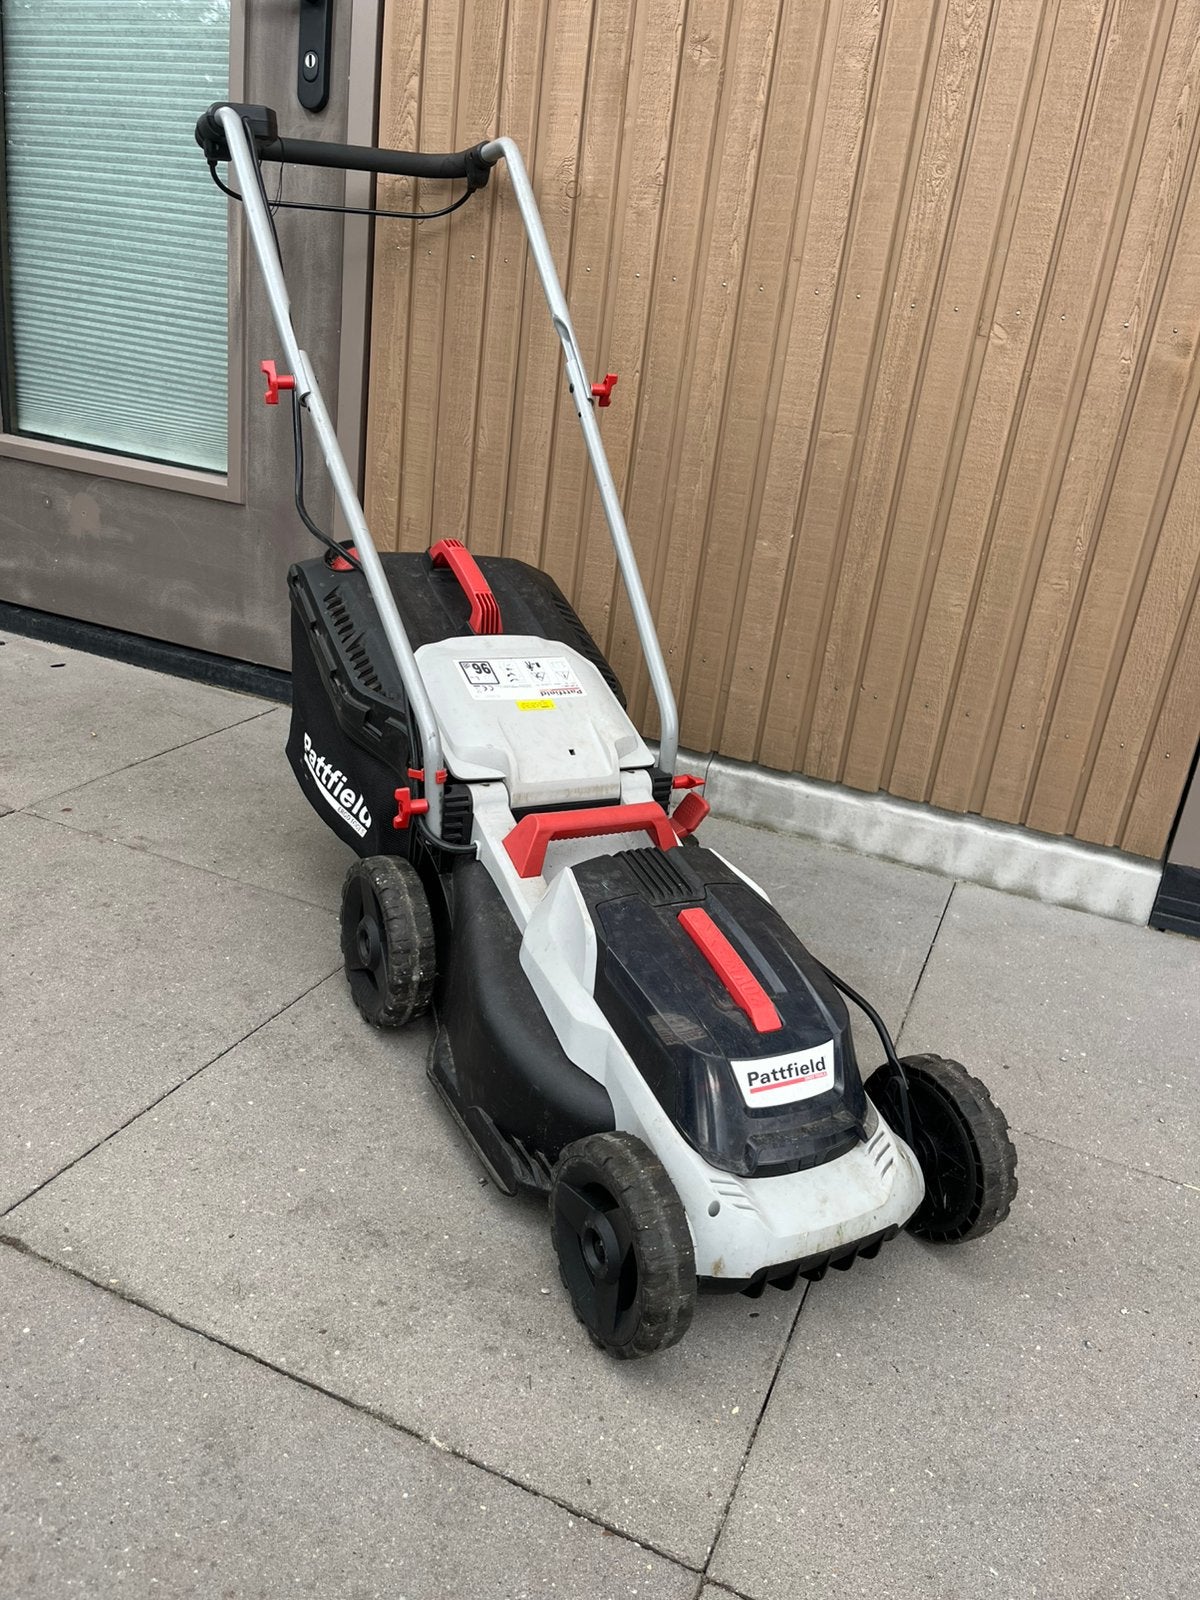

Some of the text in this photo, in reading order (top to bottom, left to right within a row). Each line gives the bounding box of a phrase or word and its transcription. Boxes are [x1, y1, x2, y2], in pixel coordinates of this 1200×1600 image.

[472, 663, 491, 675] 96
[540, 689, 583, 697] Pattfield
[747, 1056, 827, 1087] Pattfield
